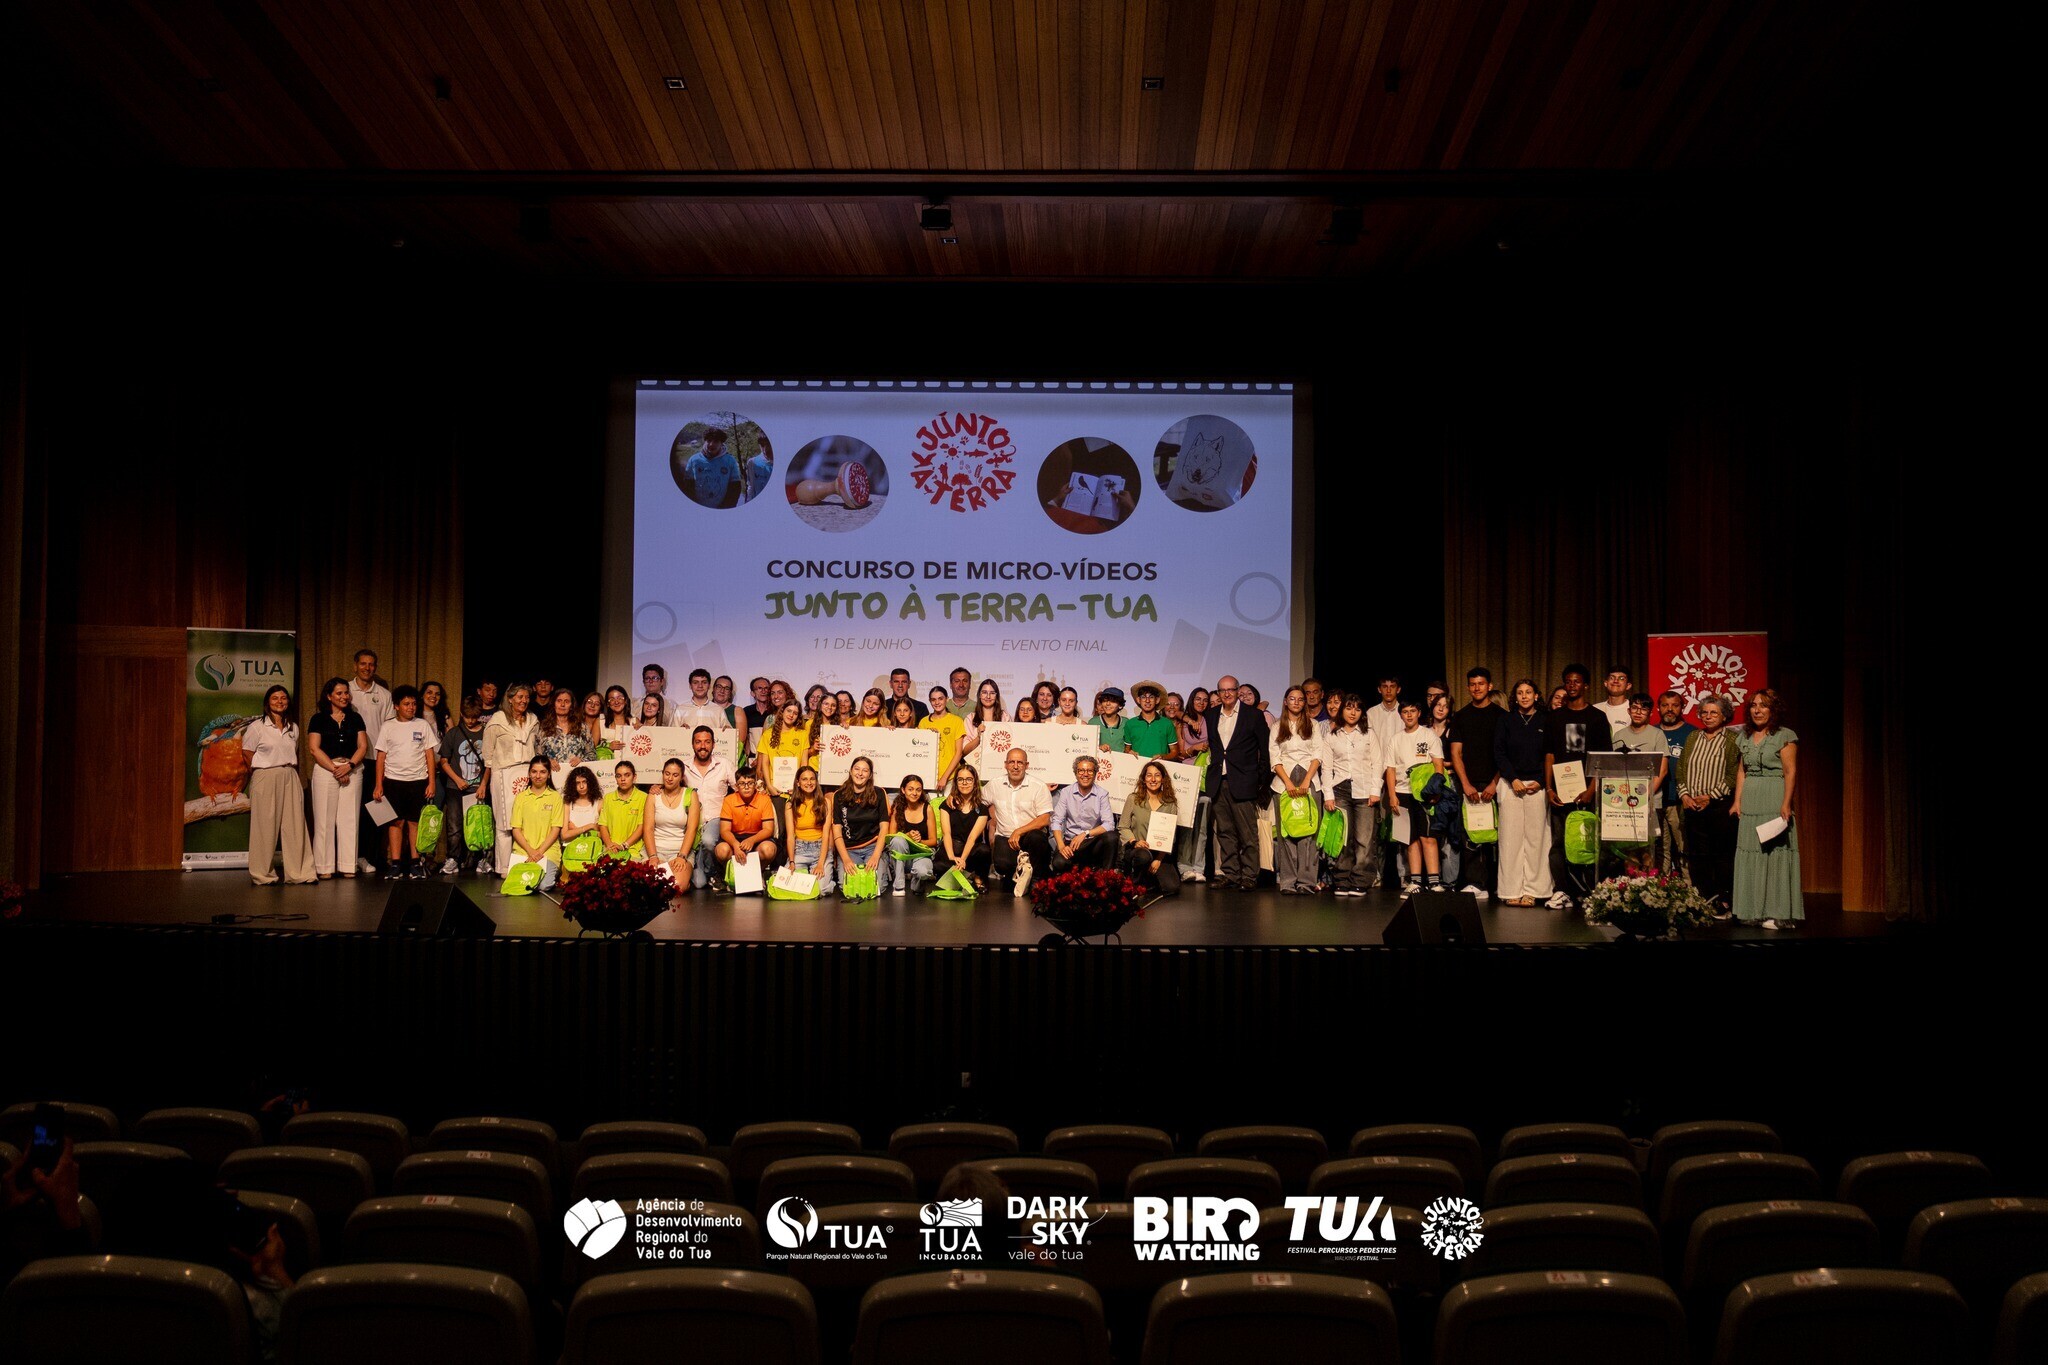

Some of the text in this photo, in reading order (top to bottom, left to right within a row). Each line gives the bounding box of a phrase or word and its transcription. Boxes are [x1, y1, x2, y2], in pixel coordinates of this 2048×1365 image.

[930, 469, 1017, 513] TERRA
[767, 558, 1158, 581] CONCURSO DE MICRO-VÍDEOS
[764, 590, 888, 620] JUNTO
[899, 584, 926, 621] À
[813, 637, 913, 651] 11 DE JUNHO
[1001, 639, 1108, 652] EVENTO FINAL
[241, 660, 284, 676] TUA
